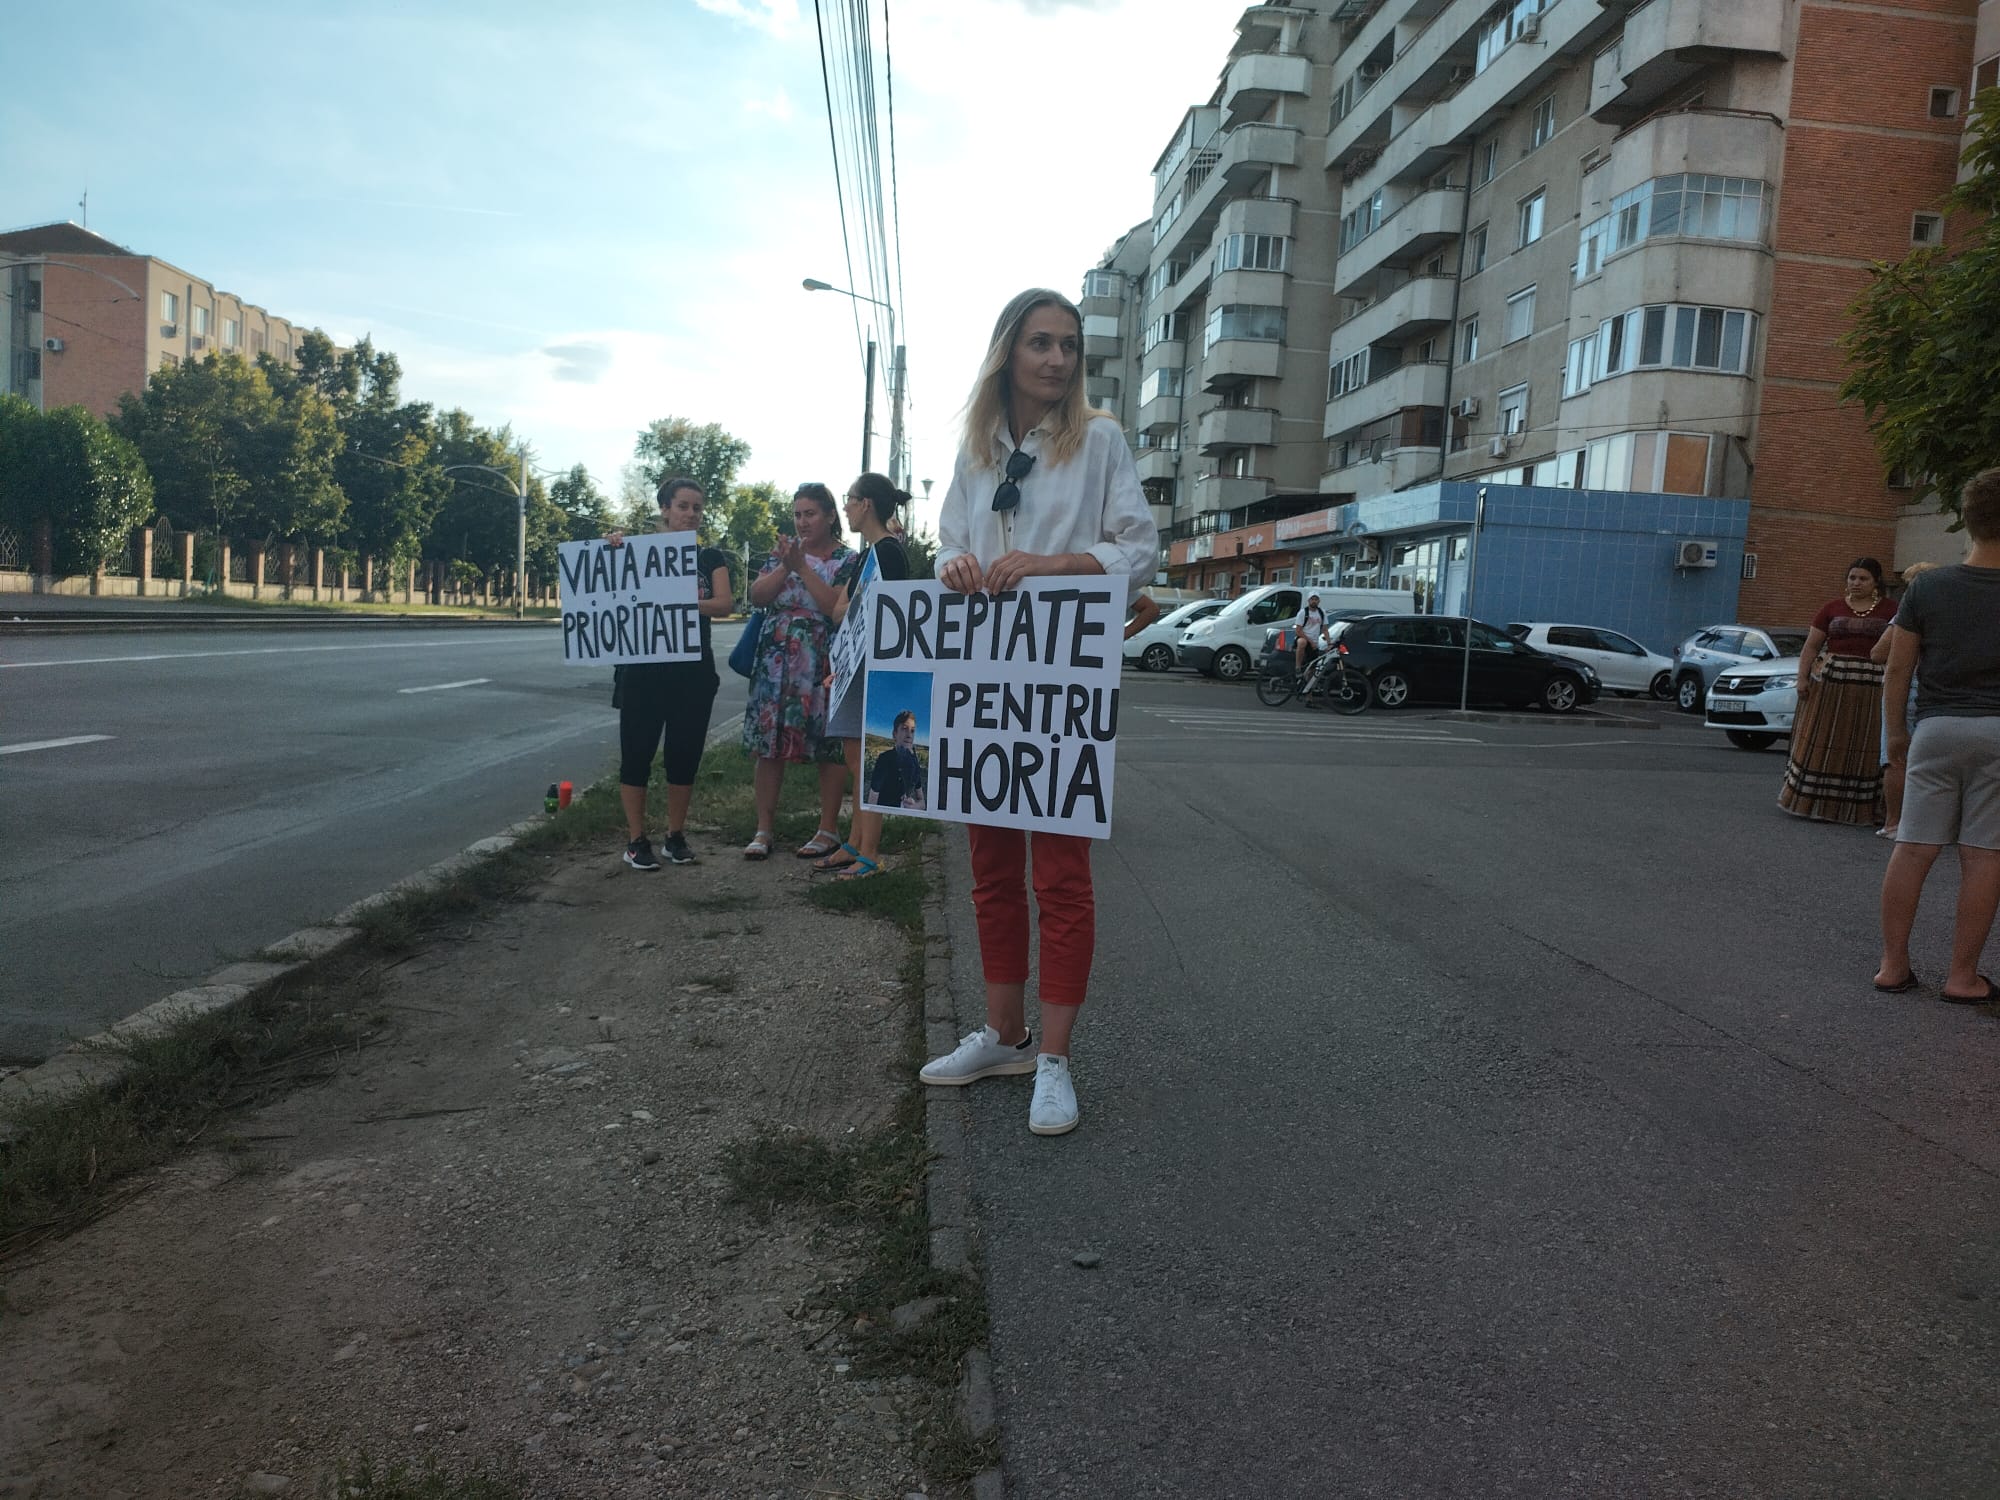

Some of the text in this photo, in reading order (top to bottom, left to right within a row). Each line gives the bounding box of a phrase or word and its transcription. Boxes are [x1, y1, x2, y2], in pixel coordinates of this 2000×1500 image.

[645, 545, 697, 577] ARE
[563, 596, 701, 659] PRIORITATE
[873, 590, 1112, 668] DREPTATE
[946, 683, 1119, 741] PENTRU
[937, 733, 1107, 823] HORIA
